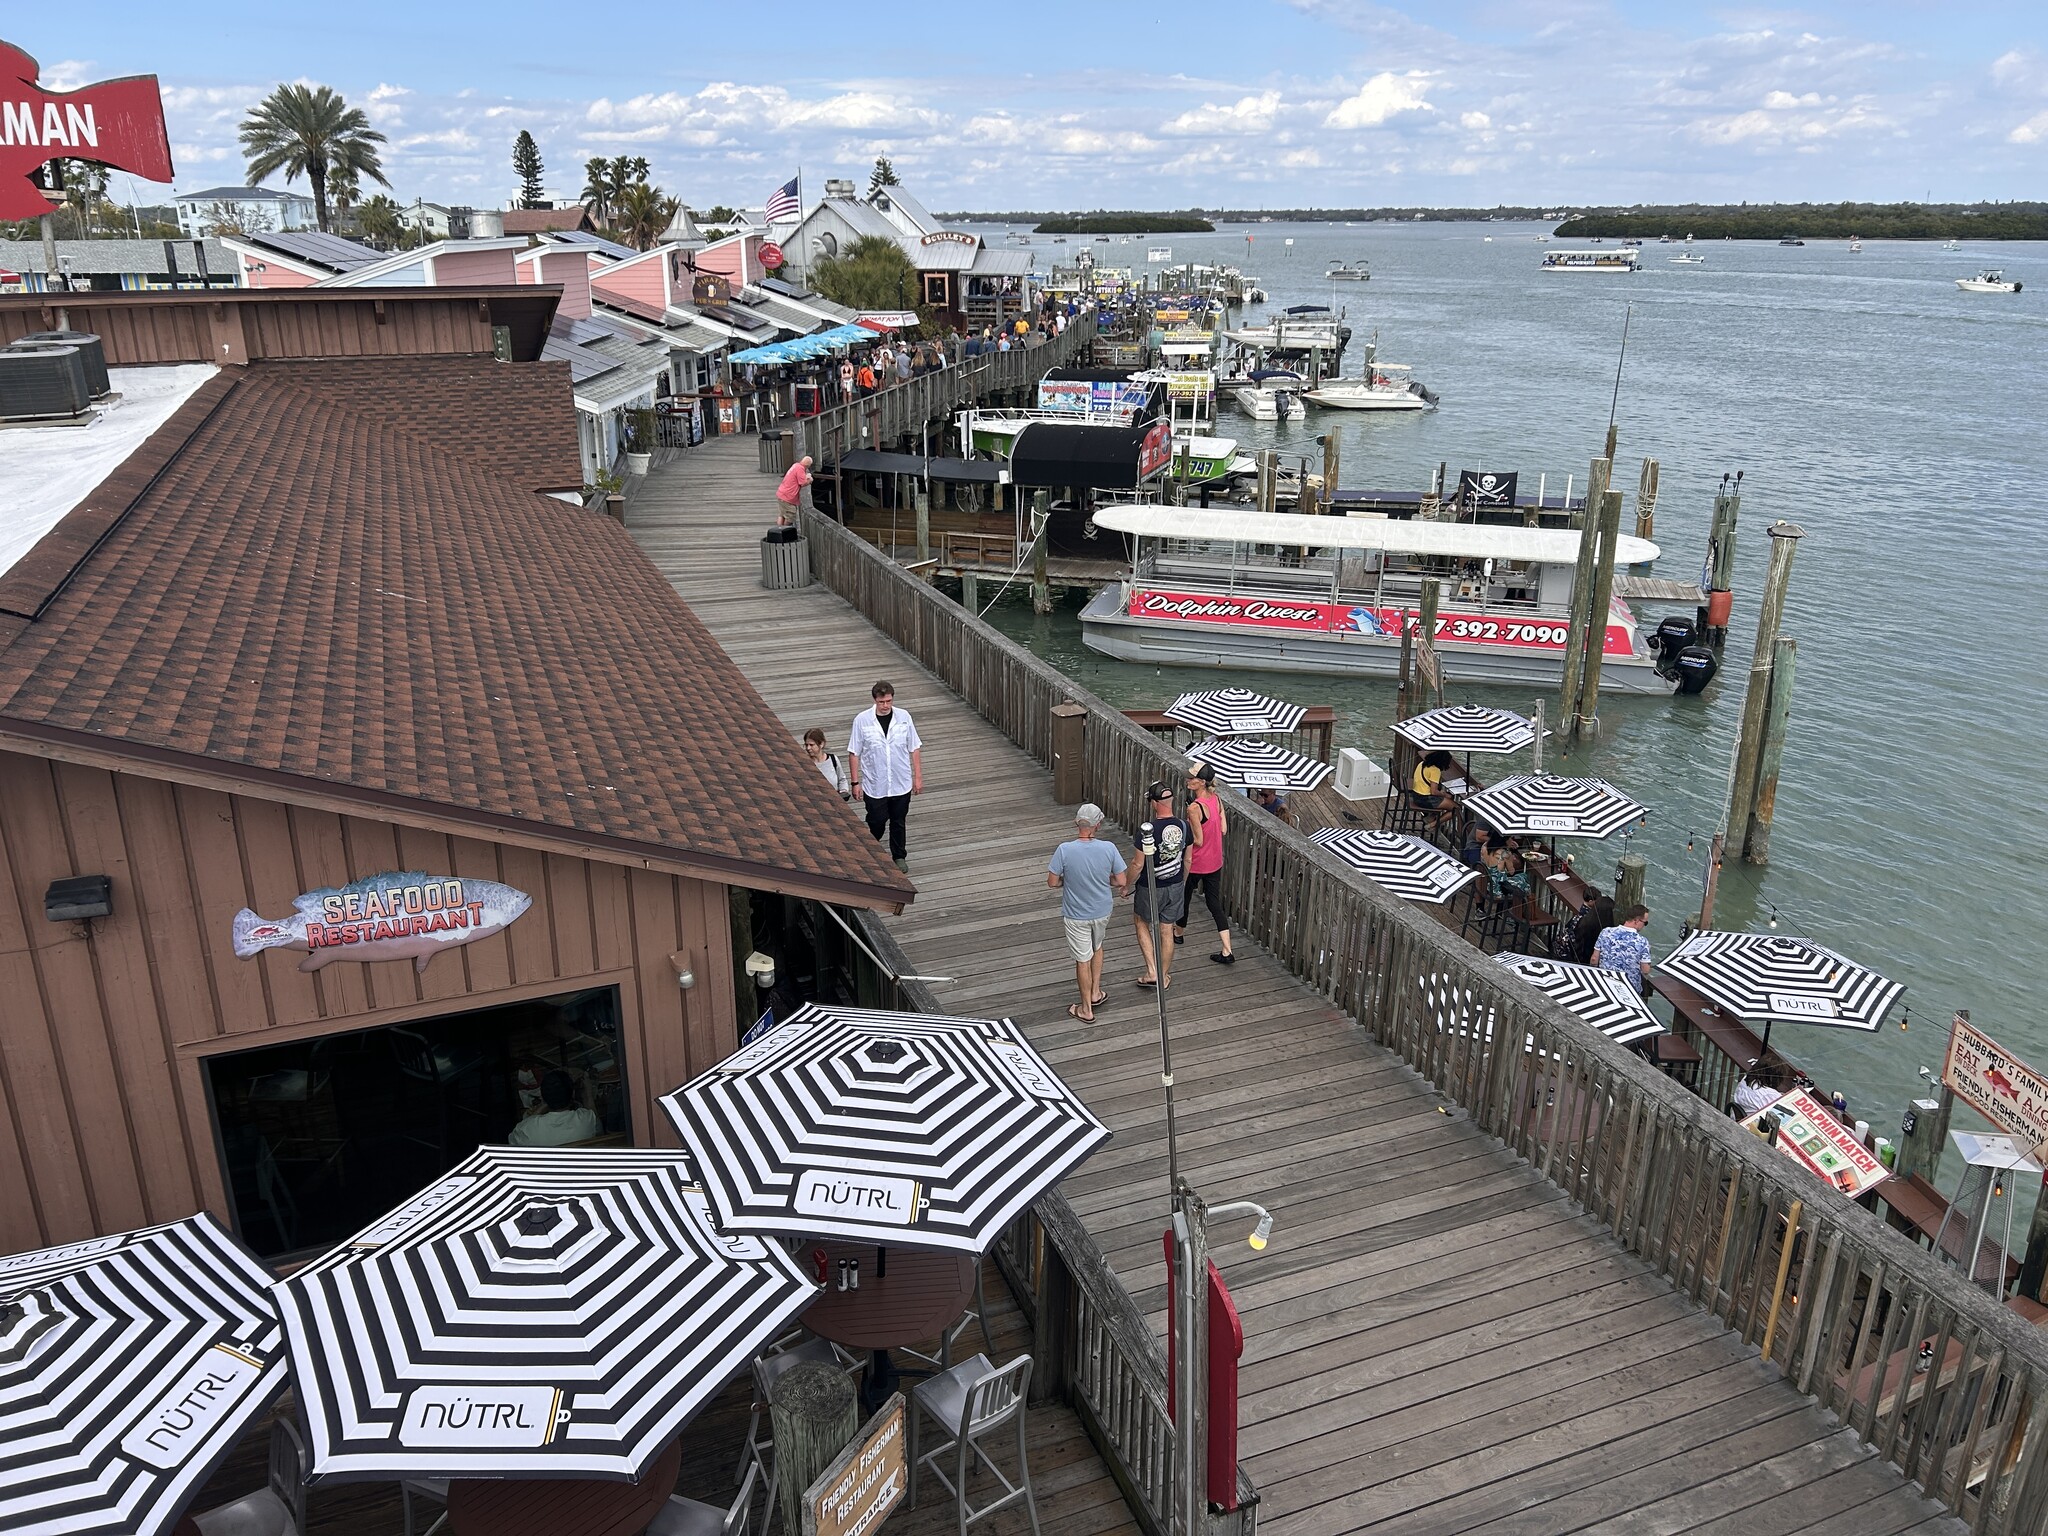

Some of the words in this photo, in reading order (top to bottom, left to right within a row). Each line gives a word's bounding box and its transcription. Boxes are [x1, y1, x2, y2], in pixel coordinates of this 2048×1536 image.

[1145, 595, 1241, 619] Dolphin
[1243, 600, 1317, 622] Quest
[323, 879, 463, 924] SEAFOOD
[306, 902, 484, 949] RESTAURANT
[1956, 1043, 1980, 1069] EAT
[1963, 1060, 1978, 1077] DECK
[1953, 1067, 1990, 1102] FRIENDLY
[1992, 1098, 2044, 1145] FISHERMAN
[1958, 1083, 1989, 1110] SEAFOOD
[2021, 1107, 2047, 1131] DINING
[1795, 1096, 1841, 1140] DOLPHIN
[1836, 1134, 1878, 1173] WATCH
[822, 1467, 857, 1519] FRIENDLY
[860, 1418, 899, 1474] FISHERMAN
[837, 1457, 886, 1526] RESTAURANT
